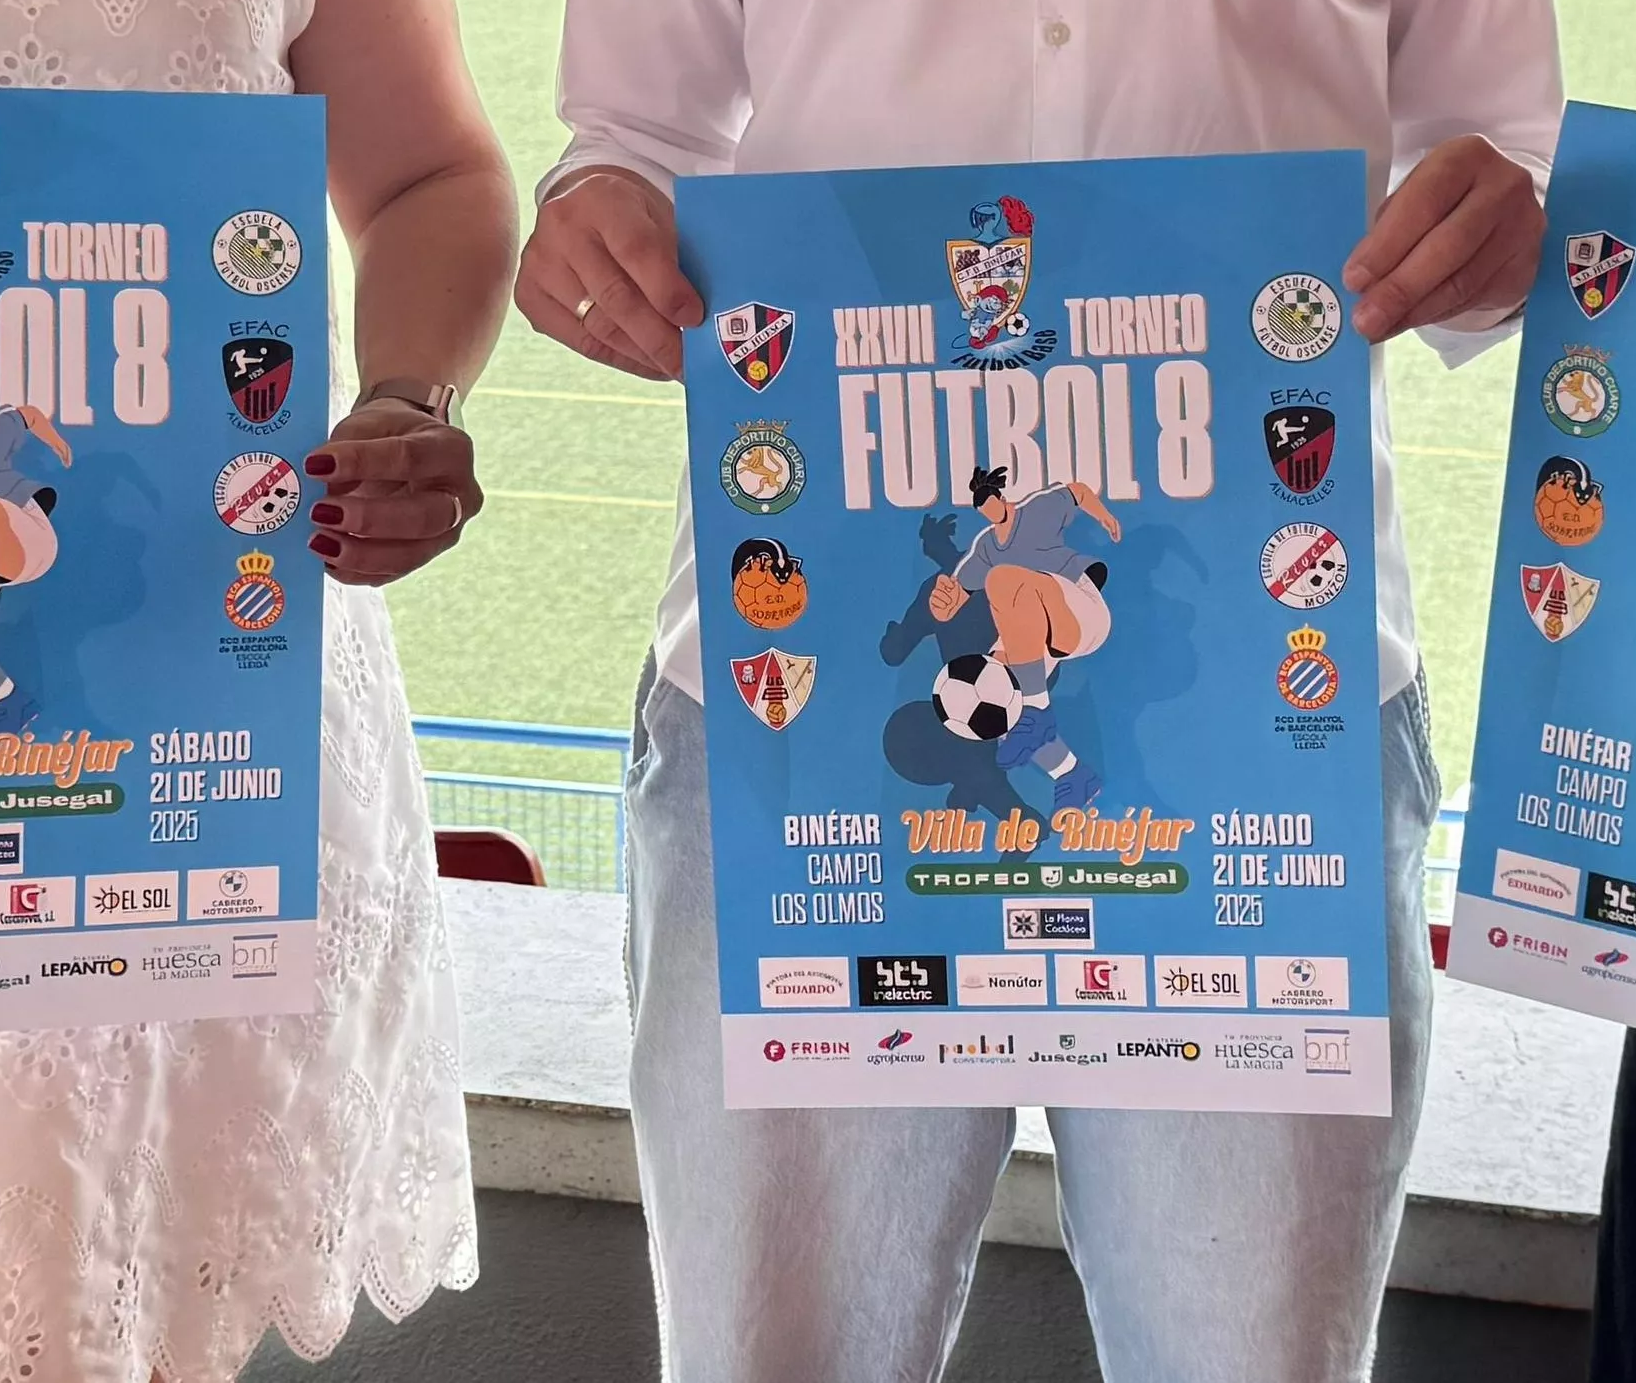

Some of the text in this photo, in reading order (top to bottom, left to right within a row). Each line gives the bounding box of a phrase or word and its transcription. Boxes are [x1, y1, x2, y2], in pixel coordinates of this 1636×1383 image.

[231, 213, 282, 231] ESCUELA
[23, 222, 170, 283] TORNEO
[1592, 250, 1631, 275] HUESCA
[255, 261, 297, 292] OSCENSE
[1269, 276, 1322, 297] ESCUELA
[229, 320, 290, 338] EFAC
[751, 318, 788, 348] HUESCA
[833, 293, 1207, 367] XXVII TORNEO
[1295, 324, 1338, 359] OSCENSE
[113, 288, 171, 426] 8
[1269, 387, 1333, 406] EFAC
[1541, 356, 1621, 426] CLUB DEPORTIVO CUARTE
[226, 408, 292, 436] ALMACELLES
[838, 360, 1215, 510] FUTBOL 8
[721, 430, 807, 498] CLUB DEPORTIVO CUARTE
[1269, 477, 1336, 507] ALMACELLES
[1287, 724, 1345, 733] BARCELONA
[150, 728, 252, 765] SÁBADO
[1540, 722, 1633, 773] BINÉFAR
[0, 788, 115, 810] Jusegal
[150, 767, 283, 804] 21 DE JUNIO
[1556, 764, 1628, 809] CAMPO
[150, 810, 200, 844] 2025
[783, 808, 882, 847] BINÉFAR
[1211, 807, 1314, 847] SÁBADO
[1517, 792, 1624, 846] LOS OLMOS
[901, 805, 1195, 866] Villa de Binéfar
[807, 852, 883, 886] CAMPO
[913, 868, 1178, 888] TROFEO Jusegal
[1213, 853, 1347, 888] 21 DE JUNIO
[121, 887, 172, 910] EL SOL
[1507, 877, 1564, 900] EDUARDO
[203, 905, 265, 917] MOTORSPORT
[771, 891, 885, 925] LOS OLMOS
[1214, 893, 1265, 927] 2025
[1514, 934, 1568, 959] FRIBIN
[41, 956, 127, 979] LEPANTO
[988, 975, 1043, 989] Nenúfar
[775, 984, 836, 996] EDUARDO
[1191, 972, 1241, 995] EL SOL
[1272, 997, 1334, 1007] MOTORSPORT
[791, 1041, 851, 1055] FRIBIN
[1028, 1051, 1108, 1066] Jusegal
[1117, 1040, 1201, 1062] LEPANTO
